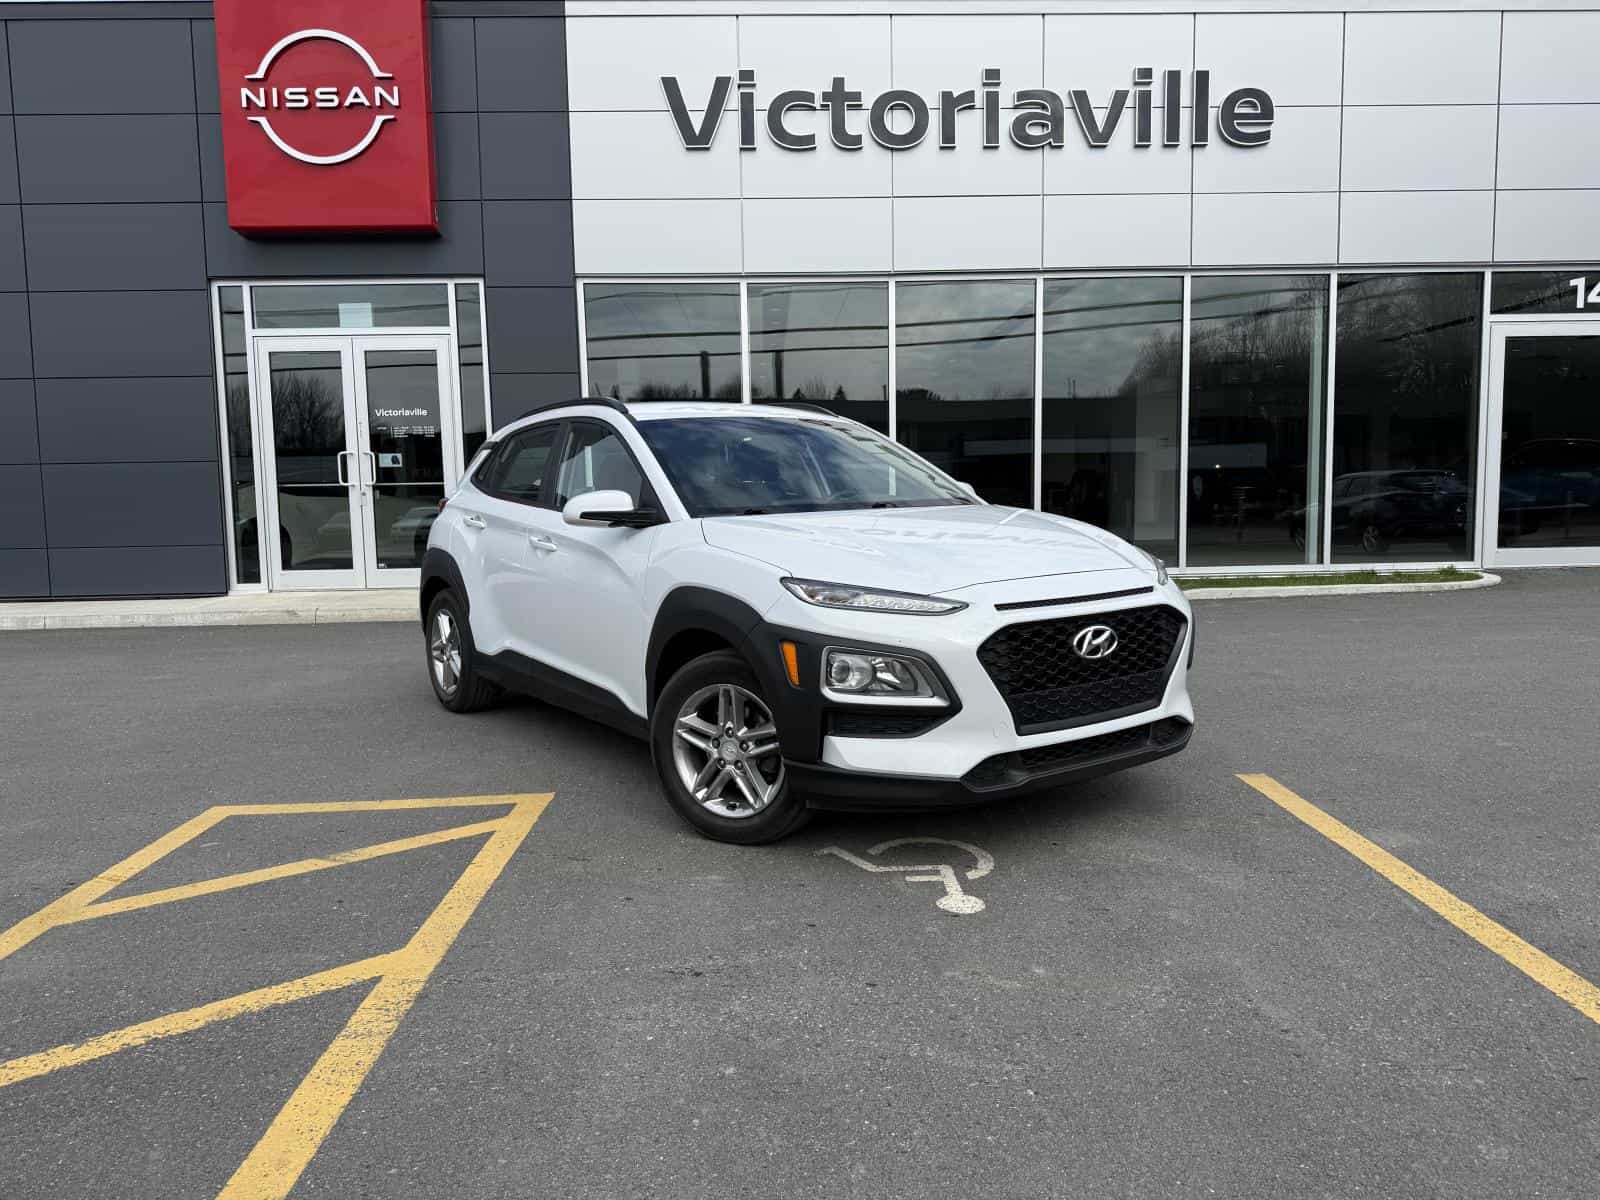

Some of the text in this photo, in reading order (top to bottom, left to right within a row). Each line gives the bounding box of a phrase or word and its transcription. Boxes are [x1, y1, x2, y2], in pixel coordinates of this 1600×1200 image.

[240, 85, 400, 108] NISSAN
[660, 68, 1275, 151] Victoriaville
[375, 407, 428, 417] Victoriaville
